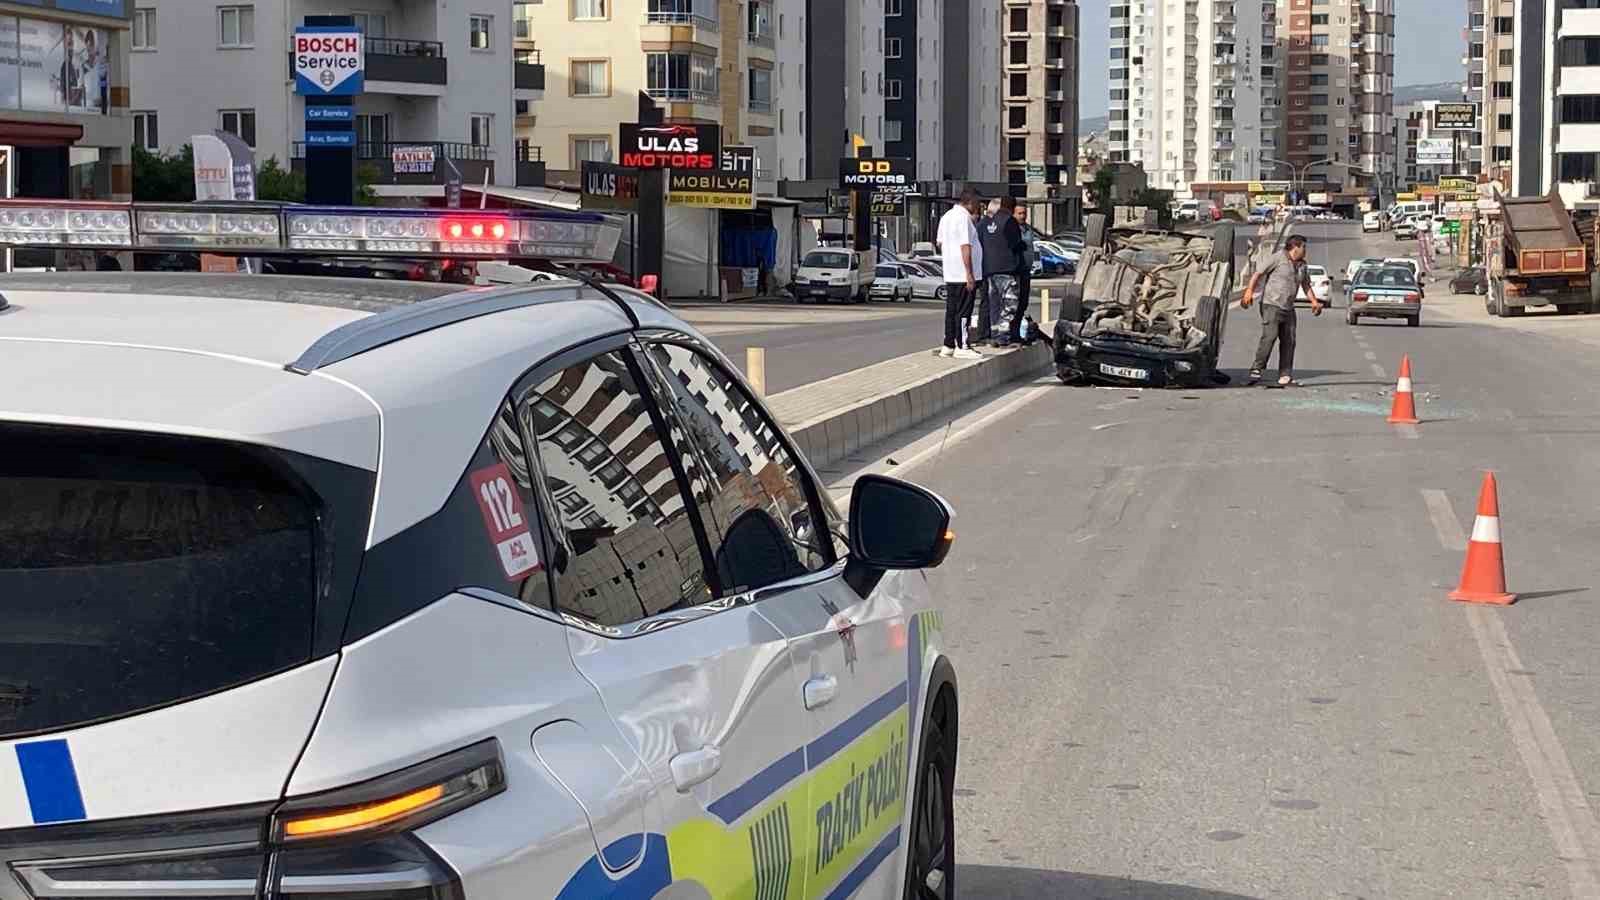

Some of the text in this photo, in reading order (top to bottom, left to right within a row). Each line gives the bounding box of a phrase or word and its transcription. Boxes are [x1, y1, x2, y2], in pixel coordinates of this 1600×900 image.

[297, 38, 357, 53] BOSCH
[297, 54, 358, 69] Service
[308, 108, 349, 117] Car Service
[638, 137, 699, 154] ULAŞ
[394, 152, 433, 161] SATILIK
[623, 154, 713, 169] MOTORS
[673, 174, 750, 190] MOBİLYA
[845, 175, 905, 184] MOTORS
[481, 477, 522, 532] 112
[816, 724, 904, 875] TRAFİK POLİSİ
